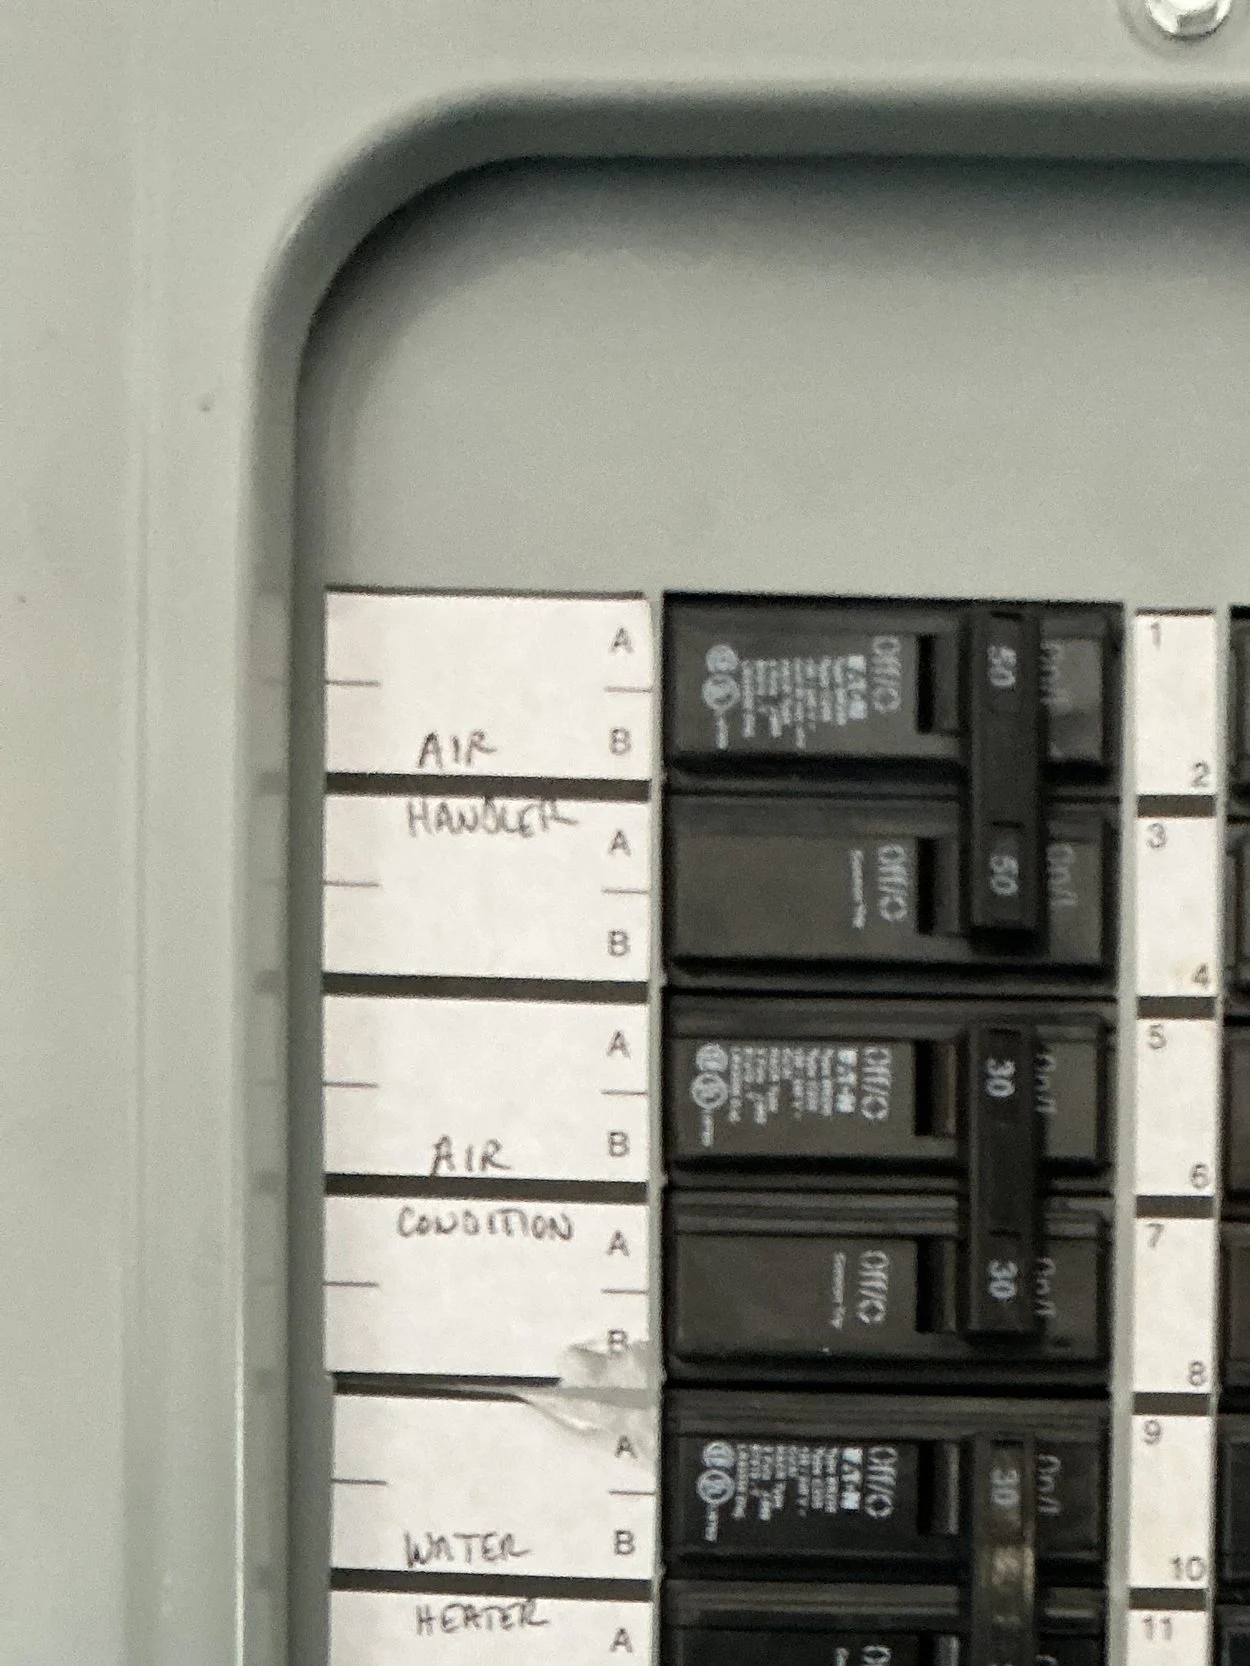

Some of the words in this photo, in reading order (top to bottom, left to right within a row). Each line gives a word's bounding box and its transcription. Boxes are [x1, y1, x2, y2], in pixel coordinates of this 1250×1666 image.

[611, 627, 633, 653] A
[1150, 622, 1162, 648] 1
[418, 730, 498, 769] AIR
[609, 727, 632, 756] B
[1190, 760, 1211, 788] 2
[407, 797, 579, 838] HANDLER
[1147, 822, 1167, 851] 3
[1191, 963, 1211, 990] 4
[606, 1030, 630, 1058] A
[1147, 1023, 1167, 1051] 5
[986, 1057, 1016, 1098] 30
[430, 1134, 513, 1177] AIR
[607, 1130, 630, 1158] B
[1189, 1162, 1211, 1190] 6
[396, 1206, 574, 1241] CONDITION
[1145, 1222, 1165, 1248] 7
[987, 1260, 1018, 1300] 30
[1187, 1360, 1208, 1387] 8
[614, 1434, 638, 1459] A
[1143, 1419, 1163, 1446] 9
[403, 1530, 532, 1568] WATER
[613, 1529, 636, 1556] B
[1170, 1555, 1207, 1582] 10
[416, 1600, 549, 1635] HEATER
[1142, 1615, 1173, 1641] 11
